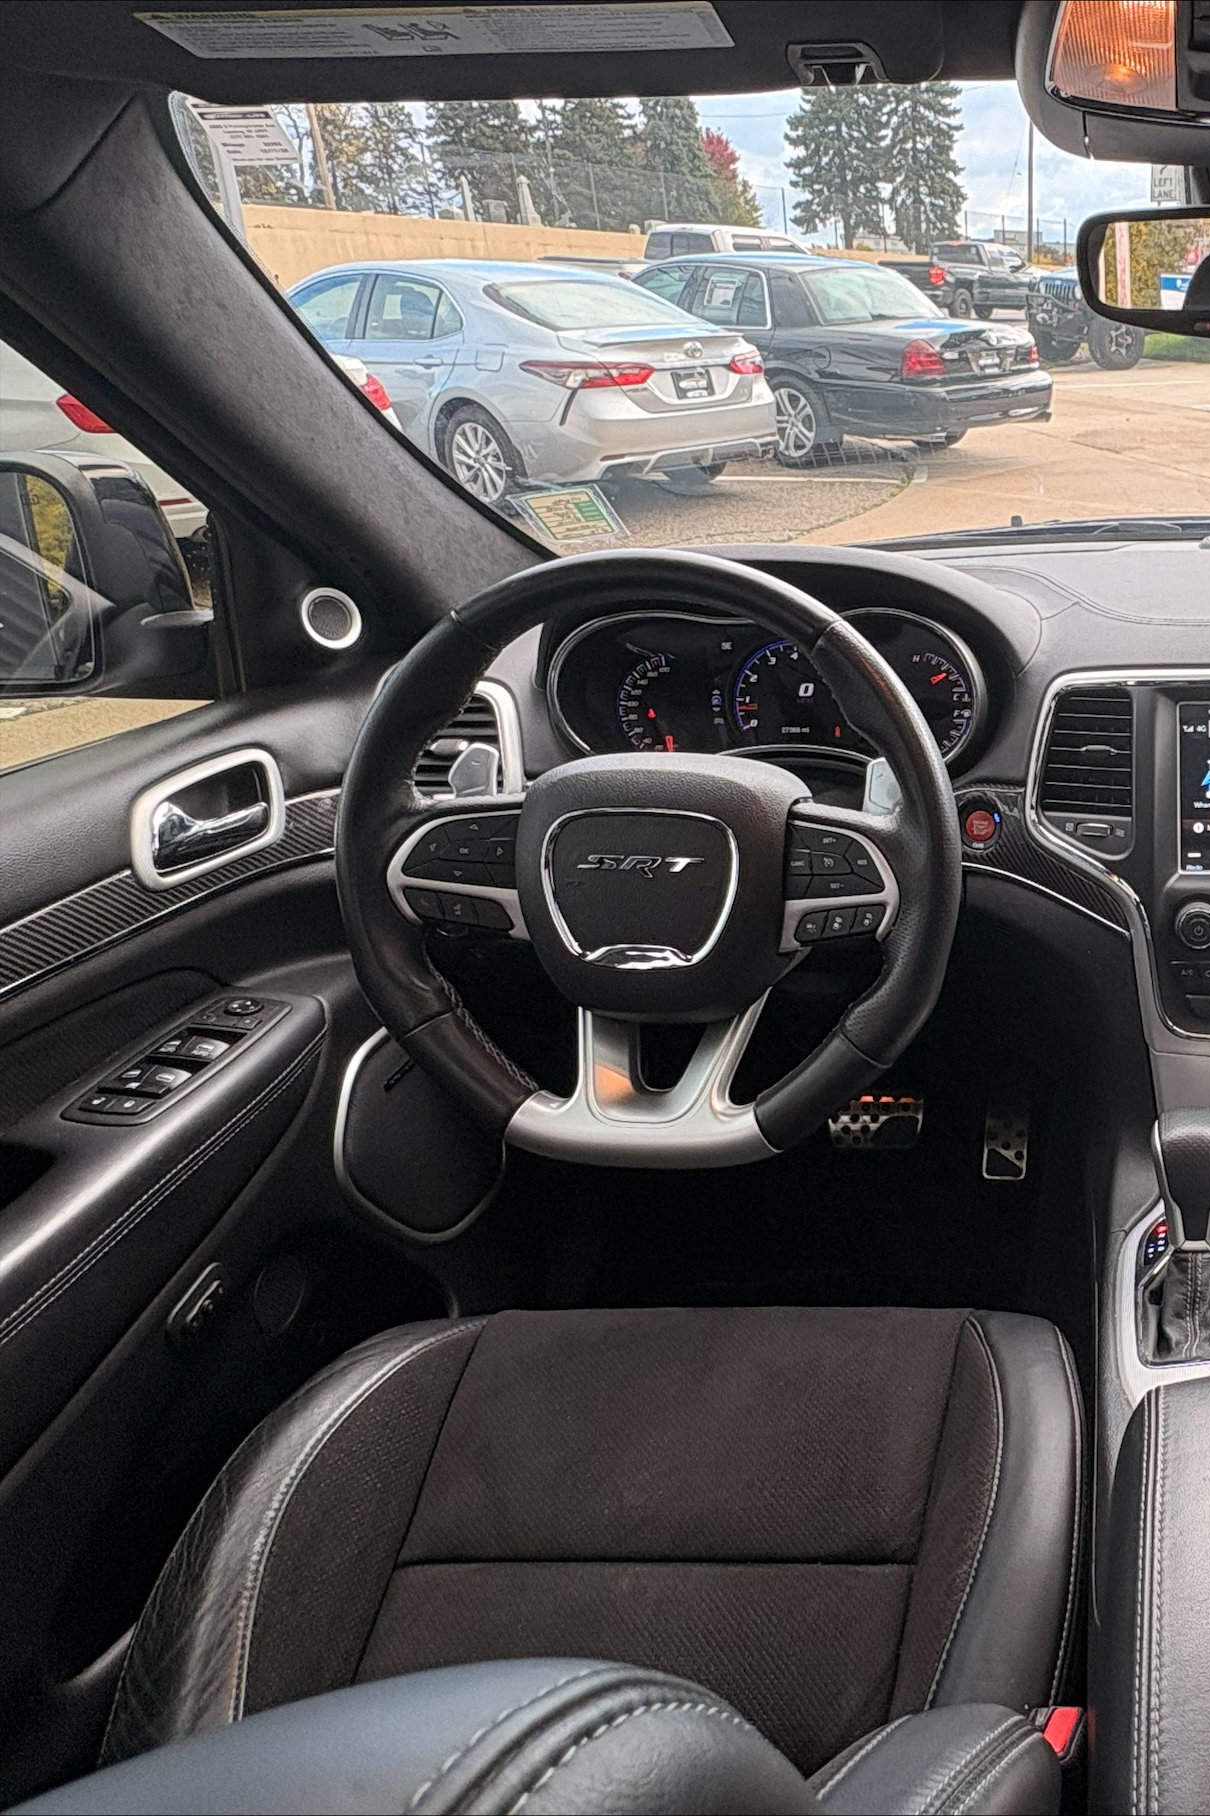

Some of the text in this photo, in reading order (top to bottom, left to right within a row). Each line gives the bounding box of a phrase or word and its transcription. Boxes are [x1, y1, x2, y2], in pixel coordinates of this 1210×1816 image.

[1153, 177, 1173, 188] LEFT
[1152, 190, 1174, 199] LANE
[768, 656, 777, 665] 3
[790, 652, 798, 660] 4
[750, 674, 758, 682] 2
[798, 682, 814, 698] 0
[750, 720, 758, 728] 0
[576, 854, 705, 878] SRT
